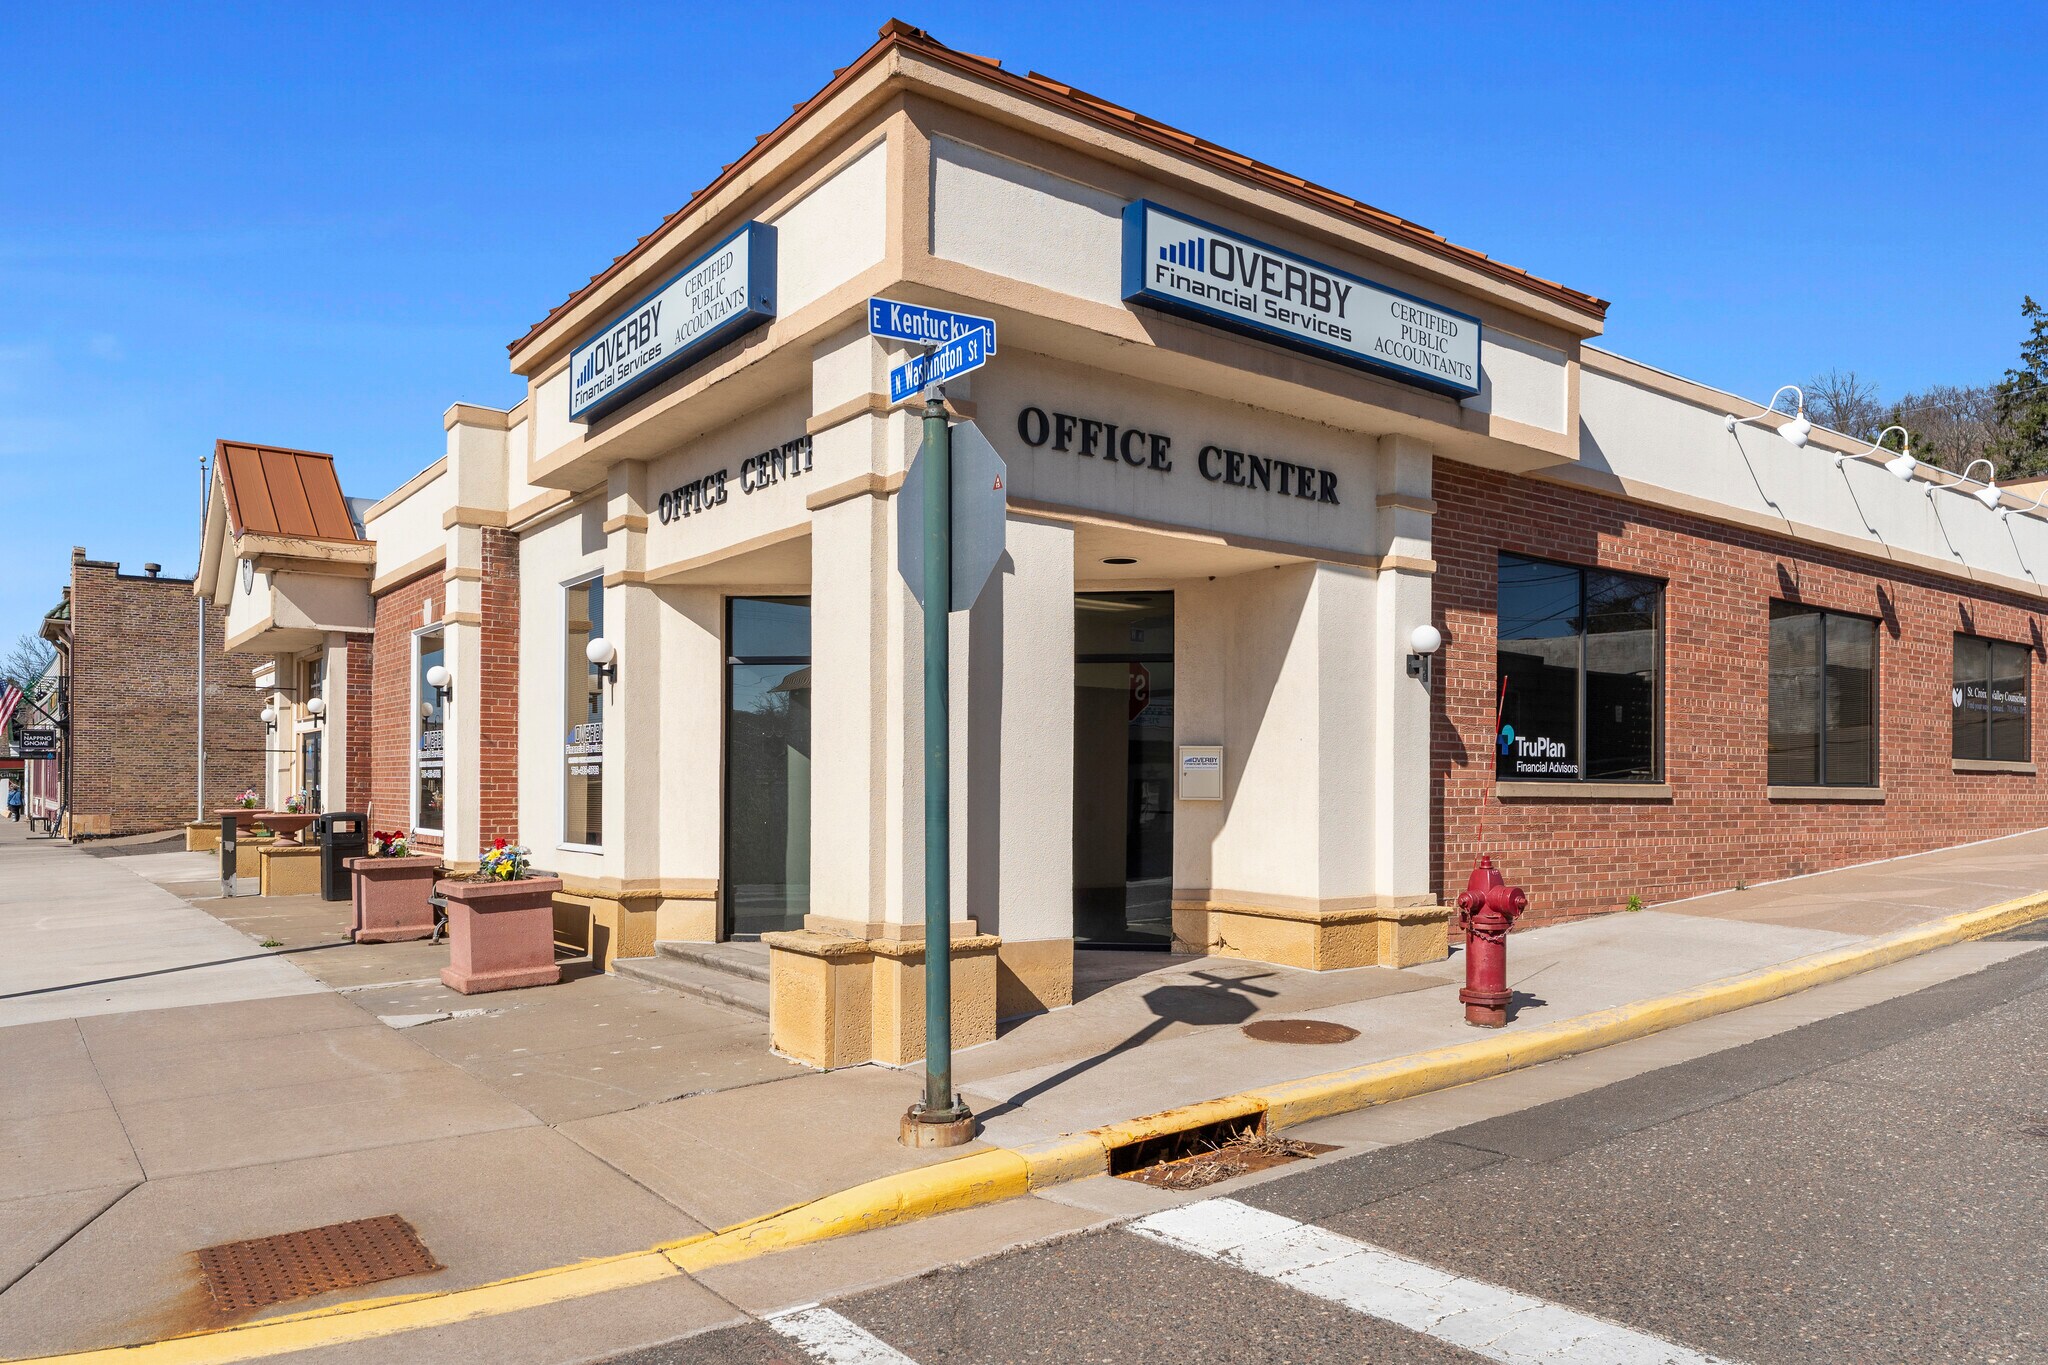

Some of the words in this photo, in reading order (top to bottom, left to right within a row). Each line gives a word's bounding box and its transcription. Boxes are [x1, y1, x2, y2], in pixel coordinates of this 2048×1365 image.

[685, 251, 734, 297] CERTIFIED
[691, 277, 726, 315] PUBLIC
[1210, 239, 1353, 319] OVERBY
[674, 286, 745, 345] ACCOUNTANTS
[873, 307, 881, 328] E
[1156, 263, 1258, 314] Financial
[1264, 300, 1352, 343] Services
[1390, 301, 1458, 338] CERTIFIED
[595, 300, 663, 376] OVERBY
[1374, 336, 1472, 381] ACCOUNTANTS
[1401, 324, 1448, 354] PUBLIC
[575, 373, 615, 408] Financial
[617, 343, 662, 381] Services
[895, 374, 901, 395] N
[904, 345, 963, 390] Washington
[968, 338, 978, 362] St
[1018, 406, 1172, 473] OFFICE
[1198, 445, 1341, 505] CENTER
[658, 469, 728, 526] OFFICE
[2004, 691, 2027, 706] Counseling
[1515, 736, 1566, 758] TruPlan
[1516, 761, 1547, 773] Financial
[1548, 761, 1579, 774] Advisors
